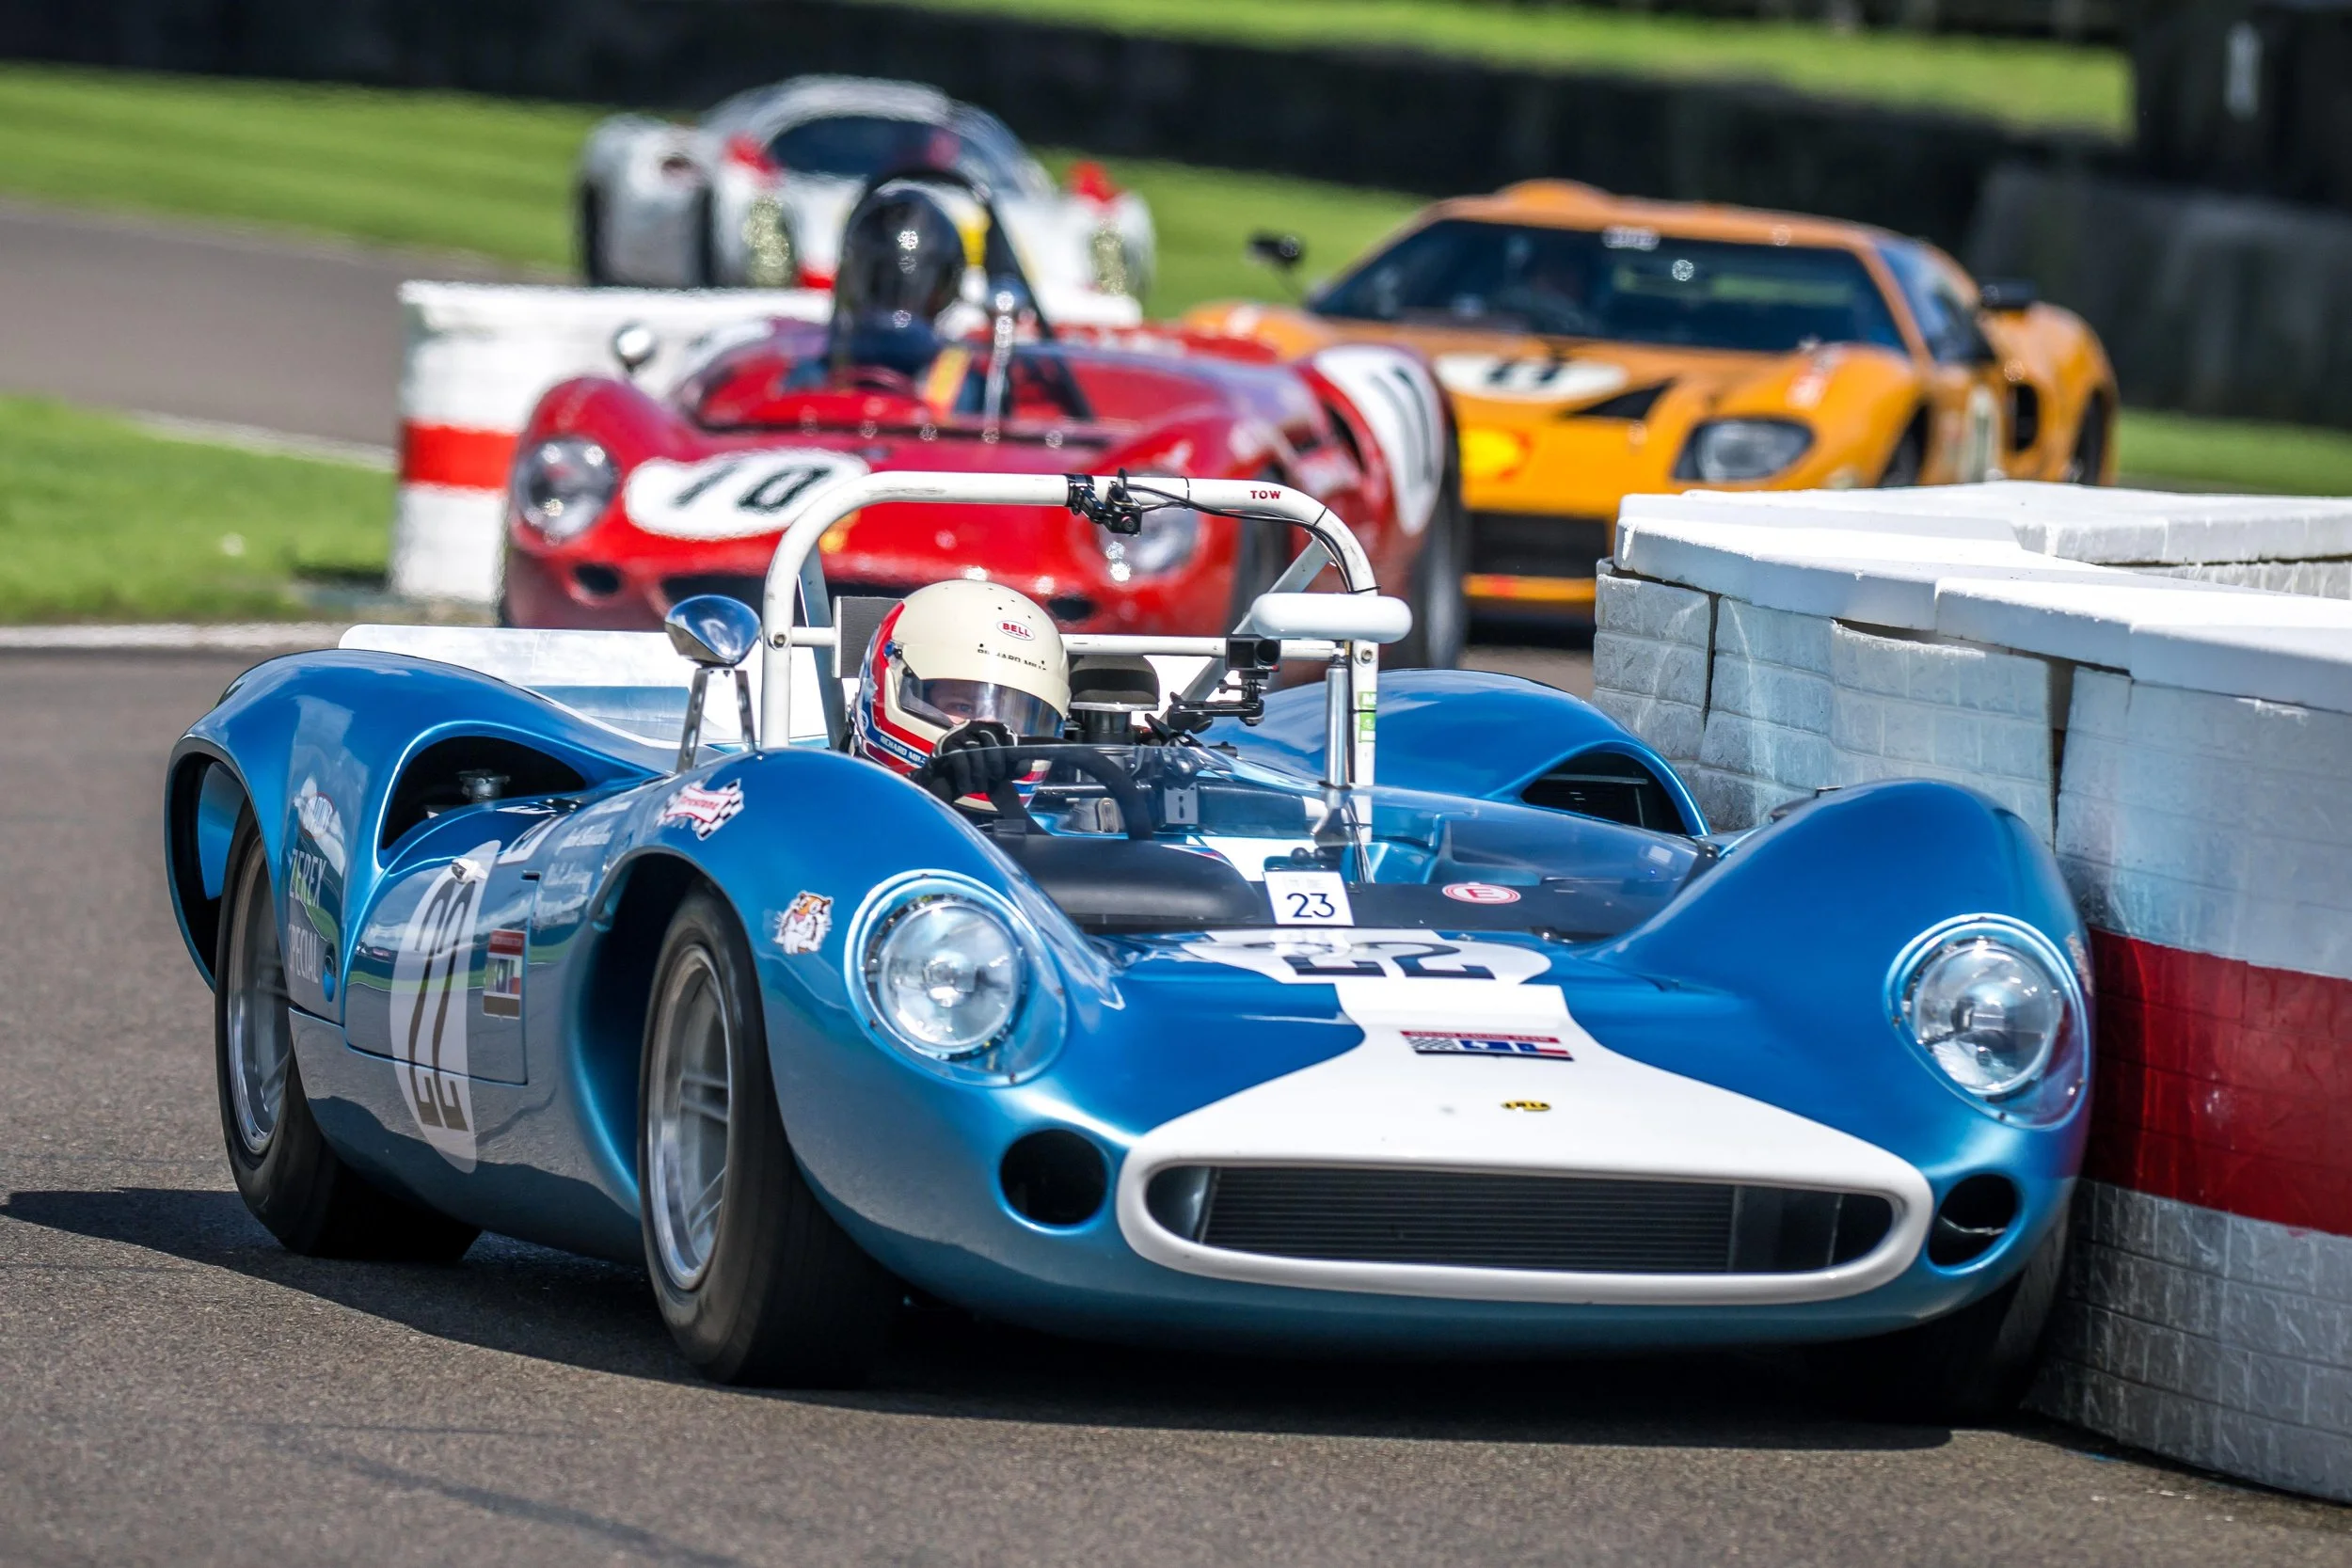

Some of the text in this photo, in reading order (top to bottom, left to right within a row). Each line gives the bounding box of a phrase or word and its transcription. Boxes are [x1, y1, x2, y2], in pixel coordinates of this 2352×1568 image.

[673, 465, 834, 515] 10
[1250, 491, 1280, 499] TOW
[1002, 623, 1031, 638] BELL
[289, 847, 327, 909] ZEREX
[1465, 888, 1503, 899] E
[1286, 893, 1336, 918] 23
[1243, 941, 1497, 980] 22
[407, 879, 476, 1132] 22
